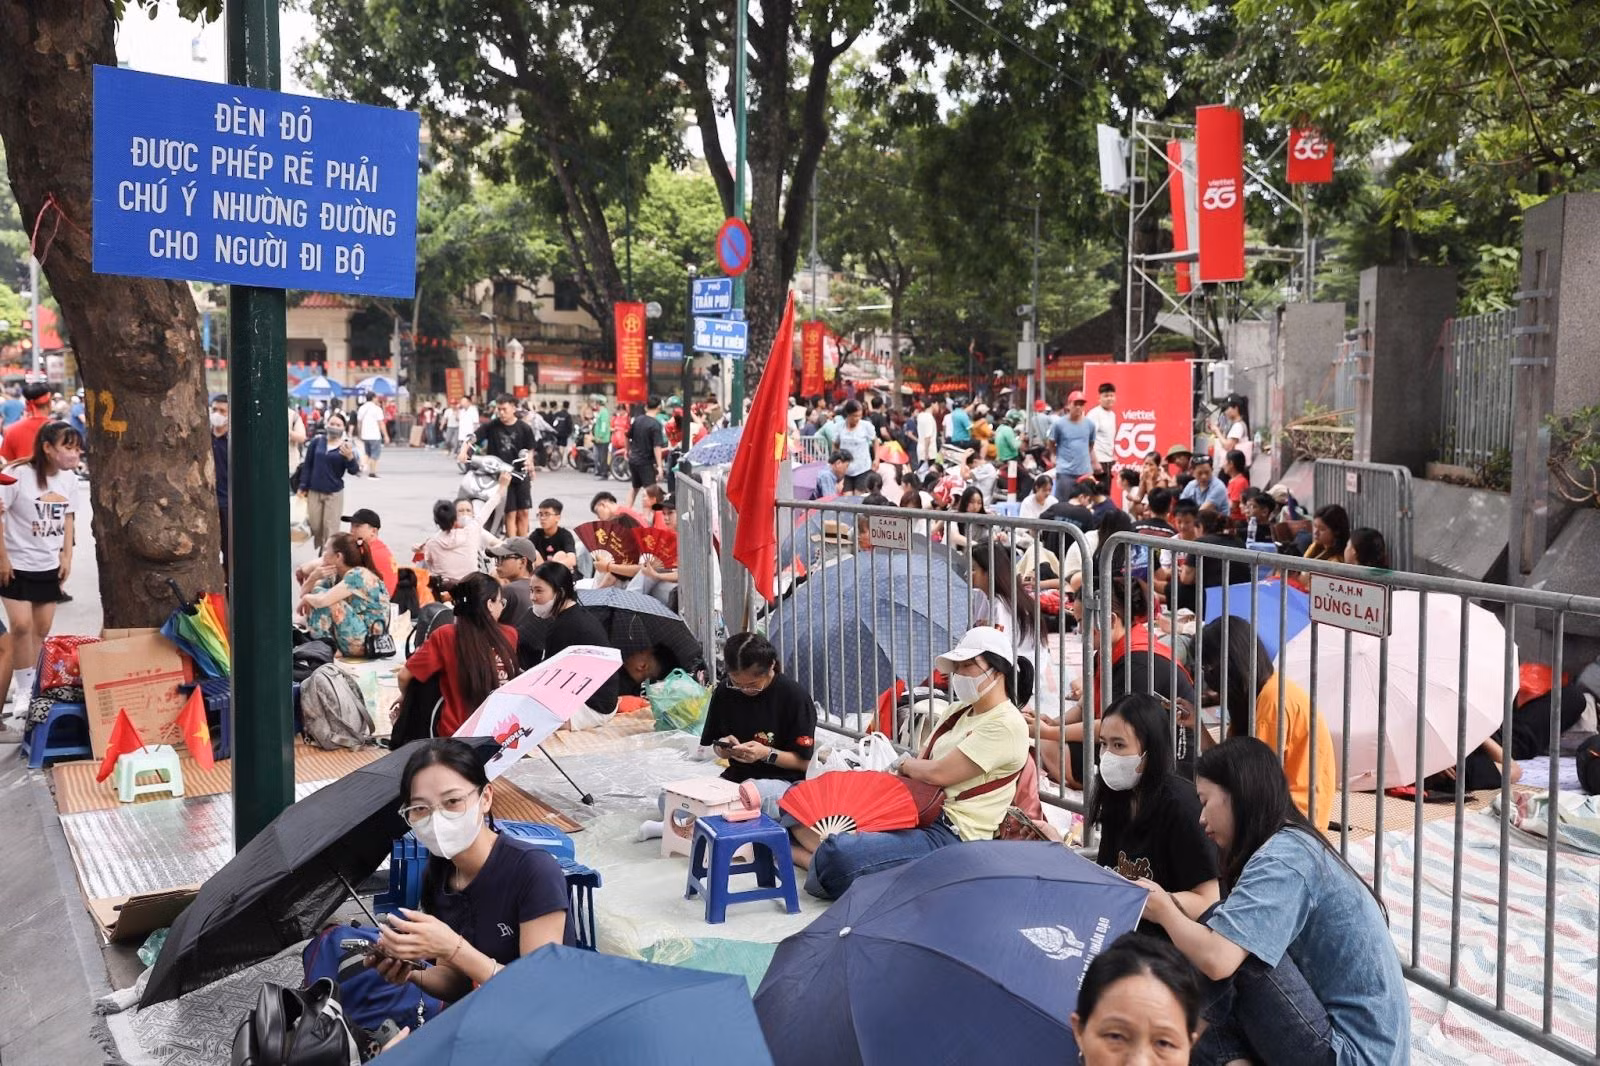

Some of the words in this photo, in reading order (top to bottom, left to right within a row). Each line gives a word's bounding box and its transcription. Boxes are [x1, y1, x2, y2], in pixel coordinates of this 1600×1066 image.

[214, 97, 265, 137] ĐÈN
[279, 105, 313, 142] ĐỎ
[130, 136, 198, 175] ĐƯỢC
[211, 144, 274, 179] PHÉP
[284, 151, 313, 186] RẼ
[326, 156, 378, 192] PHẢI
[118, 178, 167, 214] CHÚ
[181, 181, 198, 216] Ý
[212, 187, 307, 227] NHƯỜNG
[319, 198, 397, 237] ĐƯỜNG
[1202, 187, 1237, 210] 5G
[149, 228, 198, 261] CHO
[215, 231, 287, 269] NGƯỜI
[299, 242, 322, 272] ĐI
[335, 243, 366, 281] BỘ
[1122, 409, 1156, 420] viettel
[1115, 422, 1156, 459] 5G
[34, 503, 69, 520] VIET
[1328, 582, 1363, 597] C.A.H.N
[1314, 593, 1351, 616] DỪNG
[1354, 604, 1379, 625] LẠI
